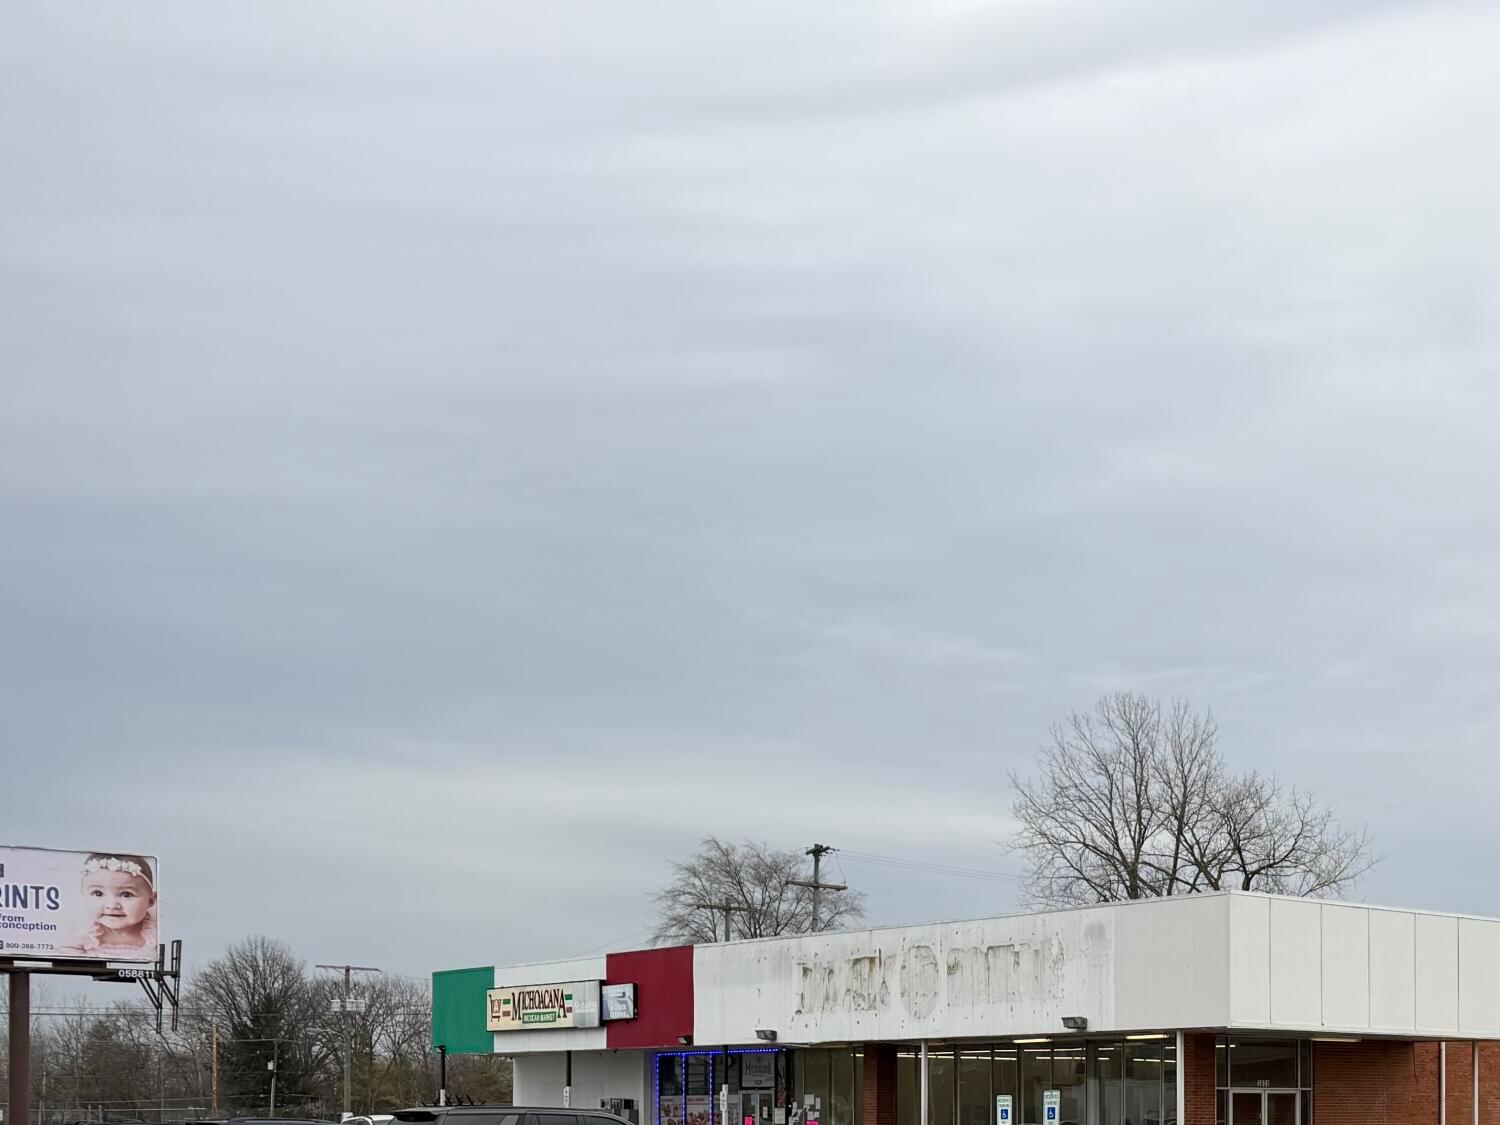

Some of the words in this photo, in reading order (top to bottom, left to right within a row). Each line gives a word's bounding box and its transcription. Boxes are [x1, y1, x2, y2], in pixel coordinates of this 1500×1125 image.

[0, 884, 60, 911] INTS
[0, 914, 24, 922] rom
[0, 922, 57, 931] onception
[118, 969, 155, 978] 058811
[512, 988, 567, 1021] MICHOACANA
